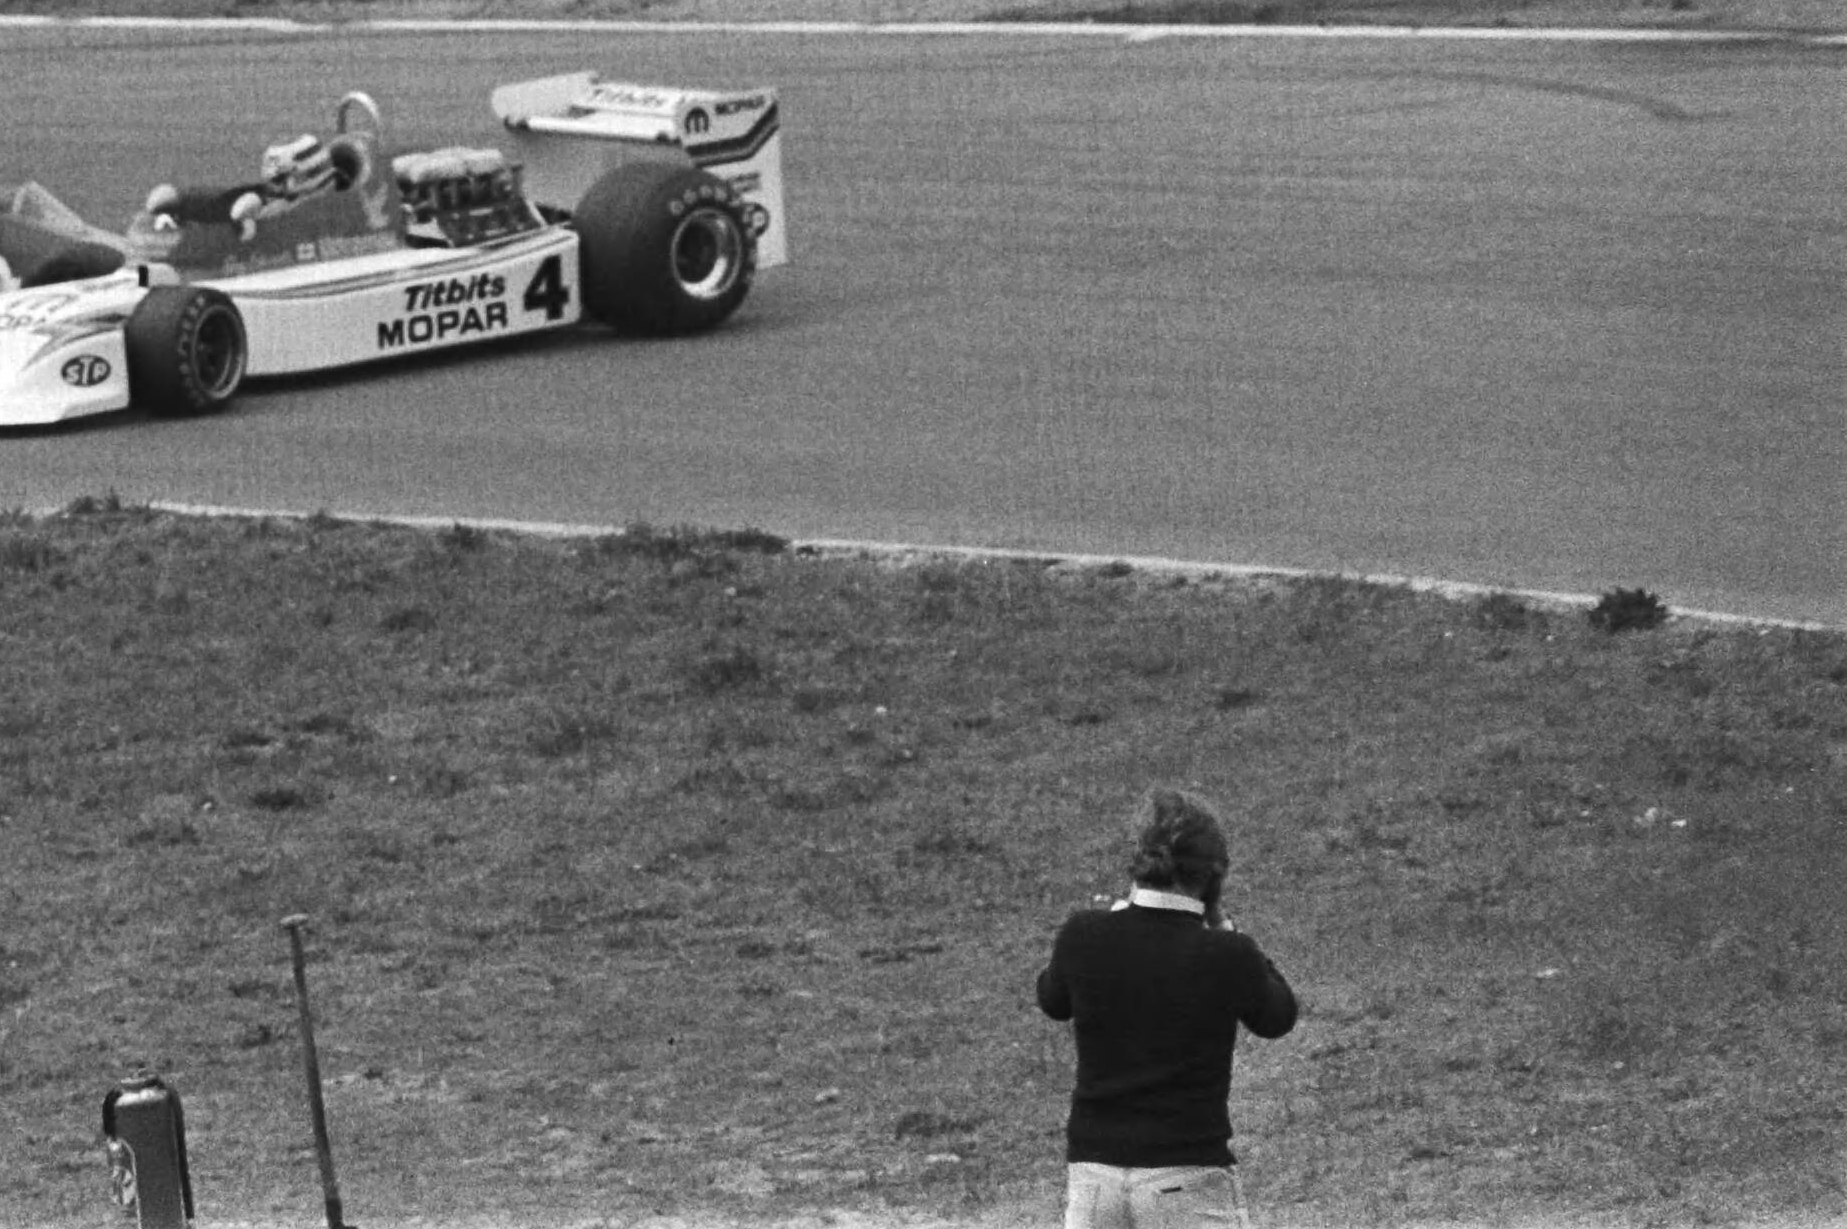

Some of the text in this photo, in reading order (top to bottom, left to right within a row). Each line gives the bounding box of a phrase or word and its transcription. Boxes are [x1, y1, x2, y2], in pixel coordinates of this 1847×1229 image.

[405, 273, 506, 312] Titbits
[523, 254, 570, 321] 4
[377, 301, 508, 350] MOPAR
[62, 355, 110, 387] STP
